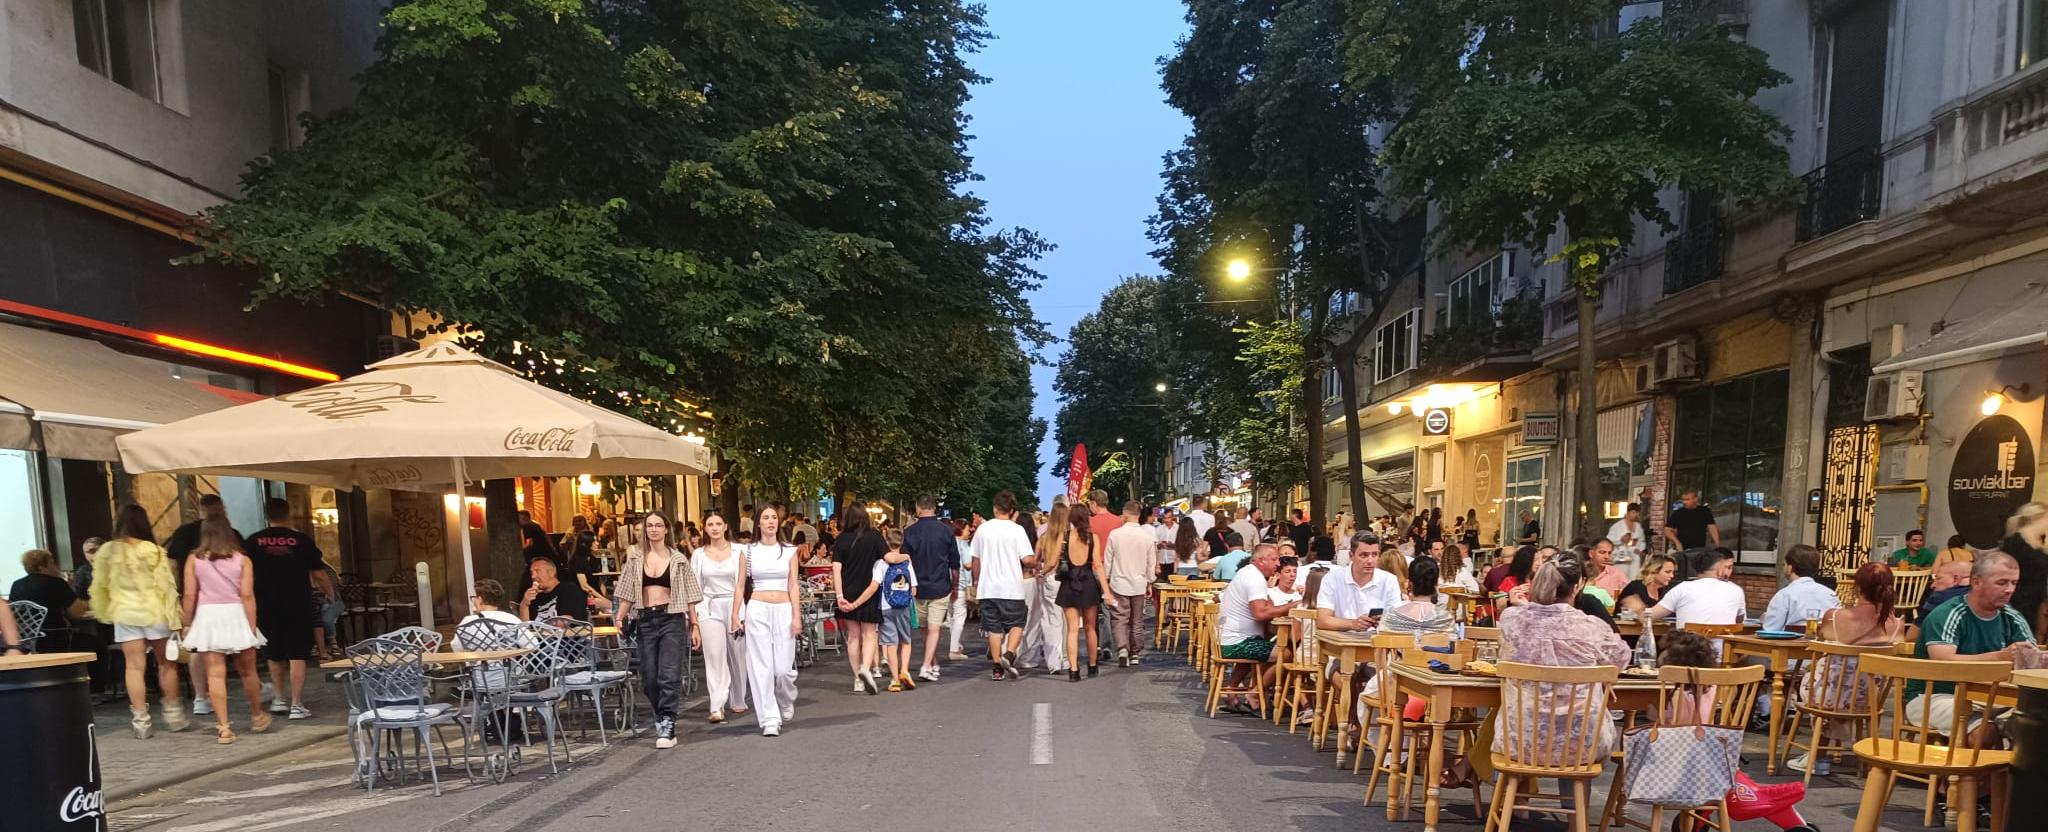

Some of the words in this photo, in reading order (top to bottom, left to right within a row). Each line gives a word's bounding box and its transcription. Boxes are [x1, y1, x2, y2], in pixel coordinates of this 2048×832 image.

[1526, 421, 1557, 436] BIJUTERIE
[504, 427, 575, 452] Coca-Cola
[2006, 474, 2031, 489] bar
[256, 536, 297, 546] HUGO
